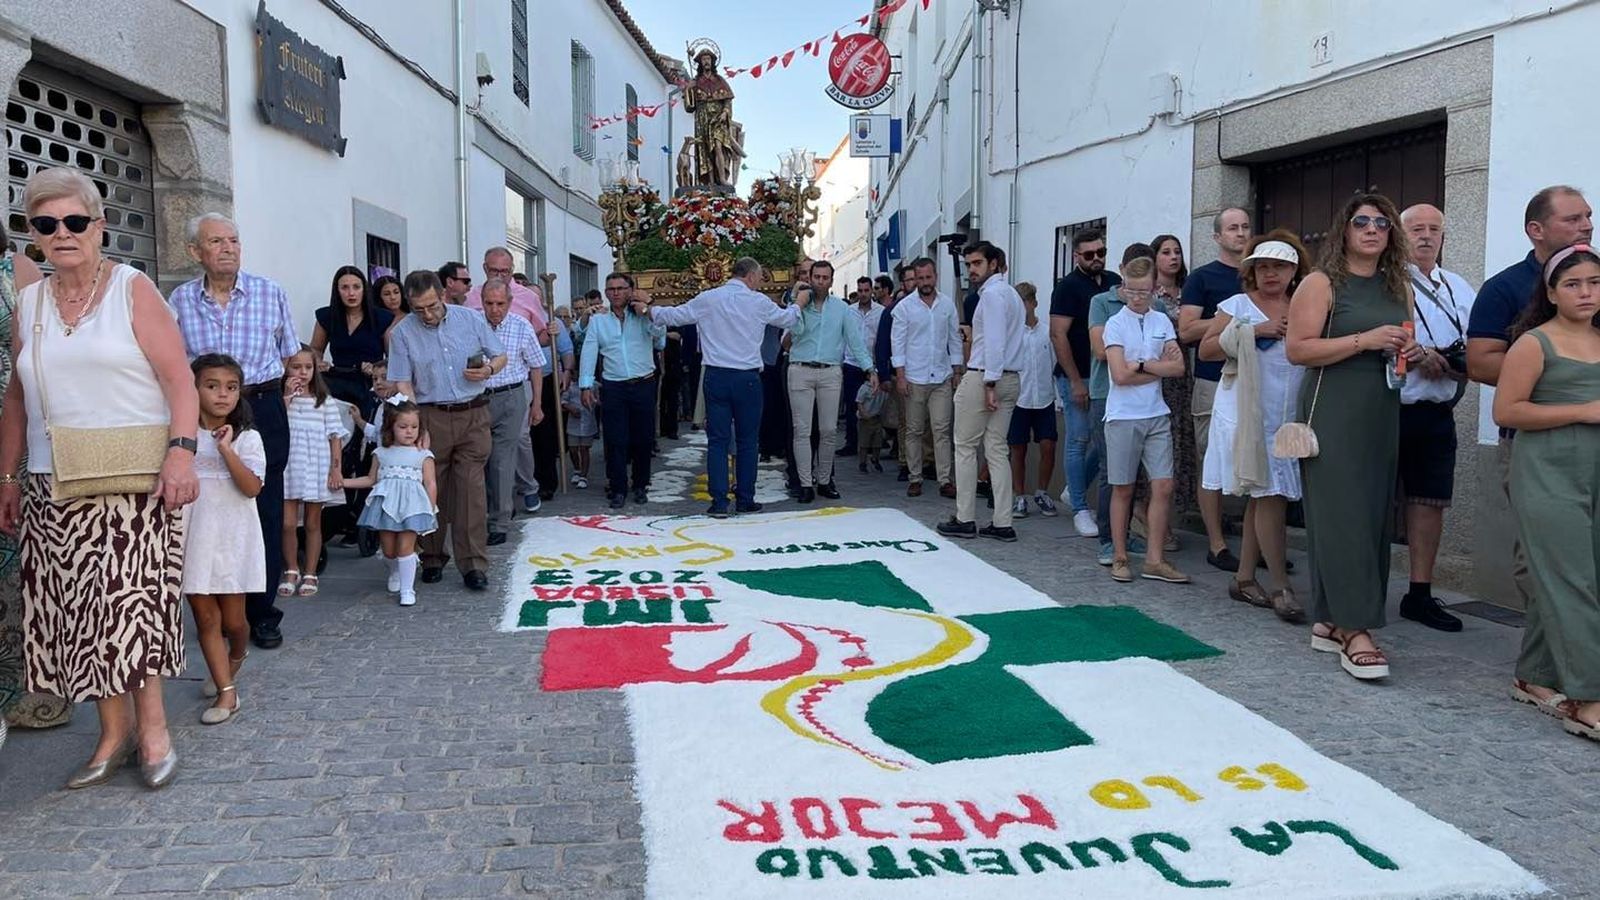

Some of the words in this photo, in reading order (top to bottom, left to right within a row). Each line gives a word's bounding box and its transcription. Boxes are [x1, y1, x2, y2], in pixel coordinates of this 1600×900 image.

[829, 86, 847, 102] BAR
[848, 98, 860, 107] LA
[862, 86, 891, 106] CUEVA
[530, 569, 706, 586] 2023
[532, 585, 714, 600] LISBOA
[517, 598, 721, 627] JMJ
[1218, 764, 1307, 792] ES
[1089, 776, 1201, 810] LO
[718, 794, 1057, 843] MEJOR
[1231, 819, 1399, 871] LA
